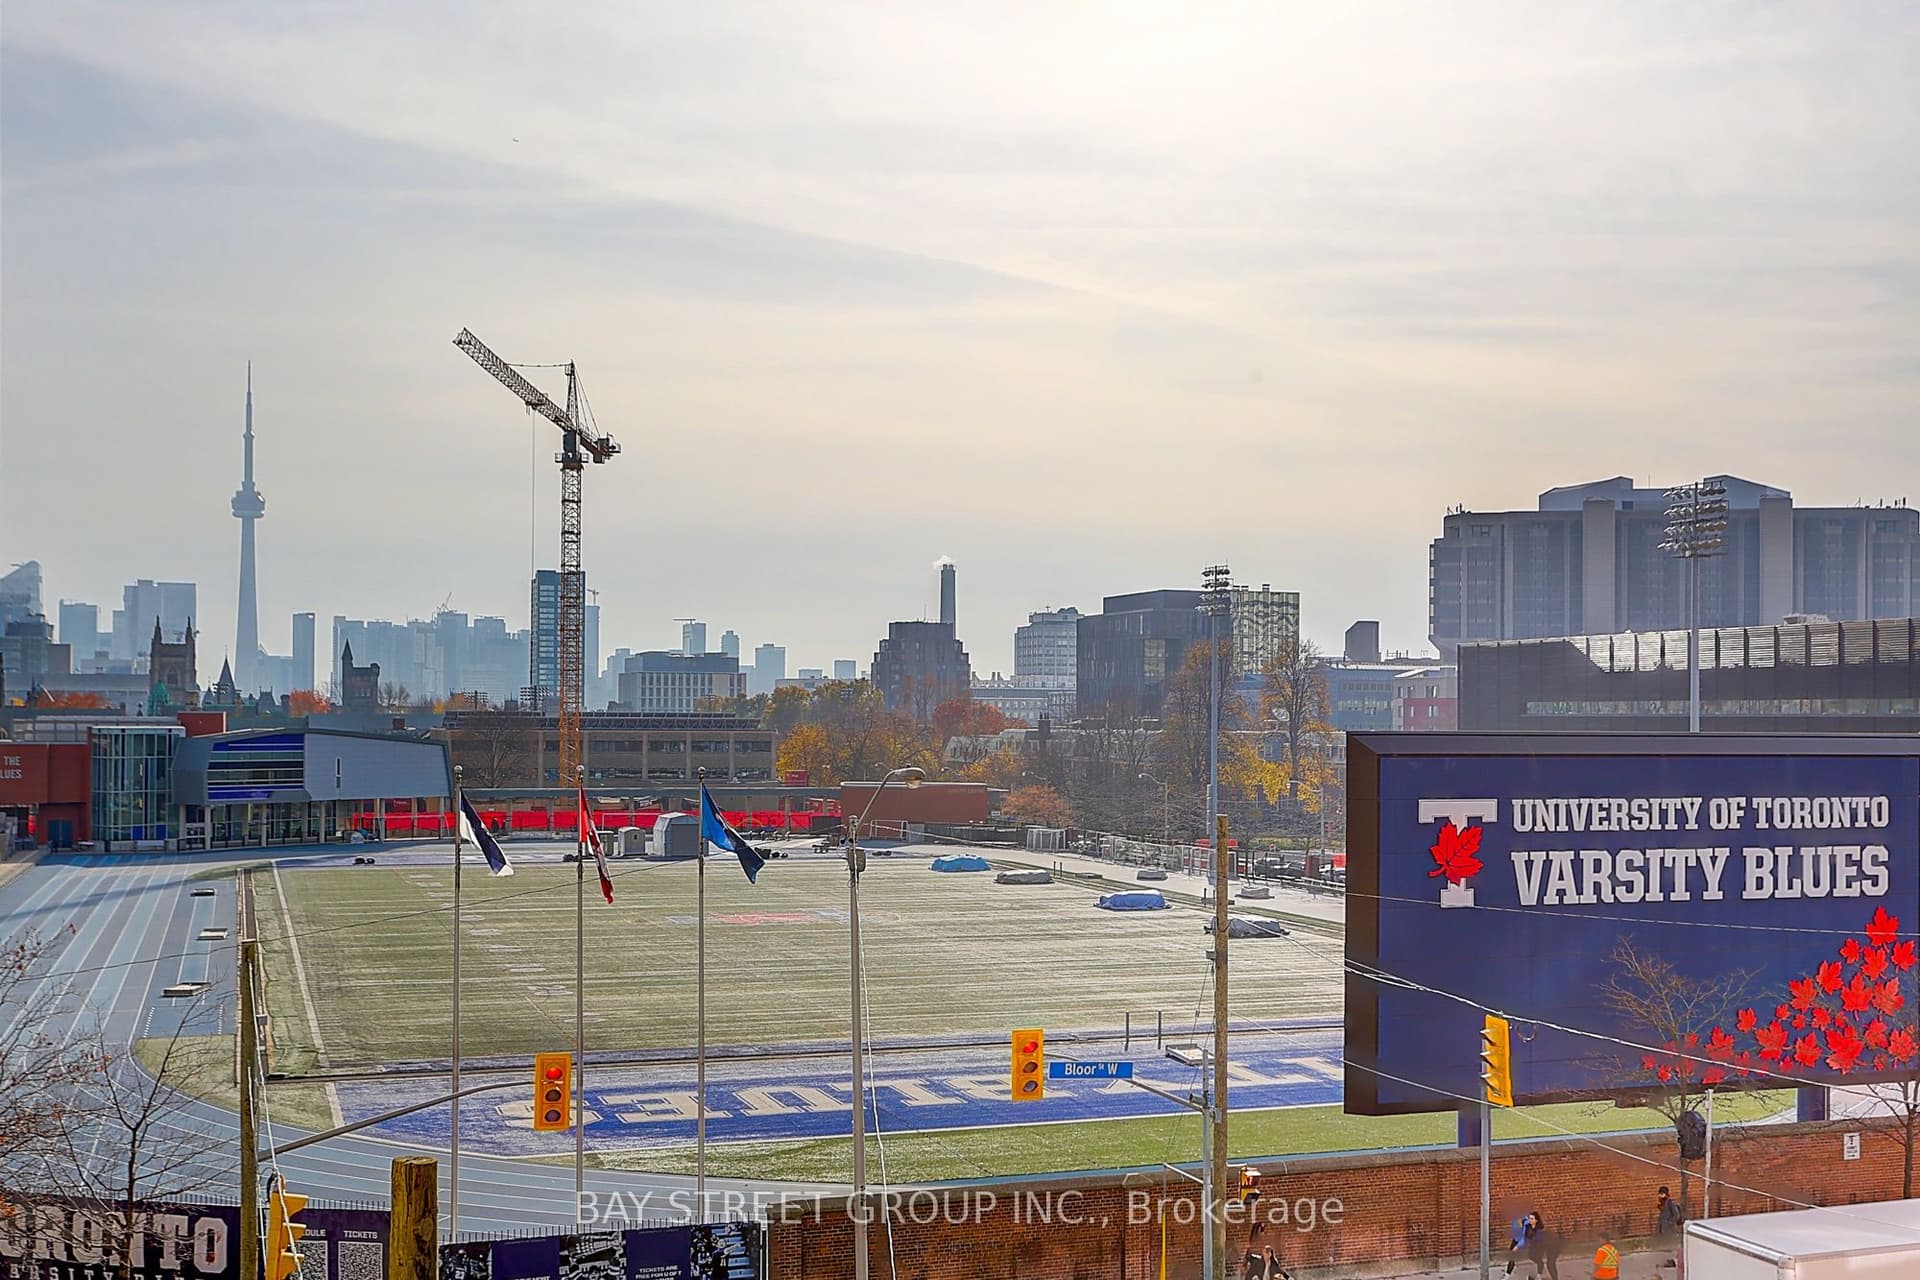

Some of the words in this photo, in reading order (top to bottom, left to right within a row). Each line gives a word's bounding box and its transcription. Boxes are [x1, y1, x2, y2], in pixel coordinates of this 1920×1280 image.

[4, 755, 21, 766] THE
[0, 769, 22, 779] LUES
[1511, 797, 1702, 833] UNIVERSITY
[1709, 797, 1747, 831] OF
[1752, 795, 1890, 830] TORONTO
[1511, 847, 1731, 907] VARSITY
[1743, 845, 1890, 901] BLUES
[1064, 1063, 1097, 1076] Bloor
[1107, 1063, 1118, 1076] W
[0, 1202, 228, 1274] ORONTO
[304, 1228, 327, 1237] DULE
[343, 1230, 378, 1239] TICKETS
[9, 1263, 114, 1280] ARSITY
